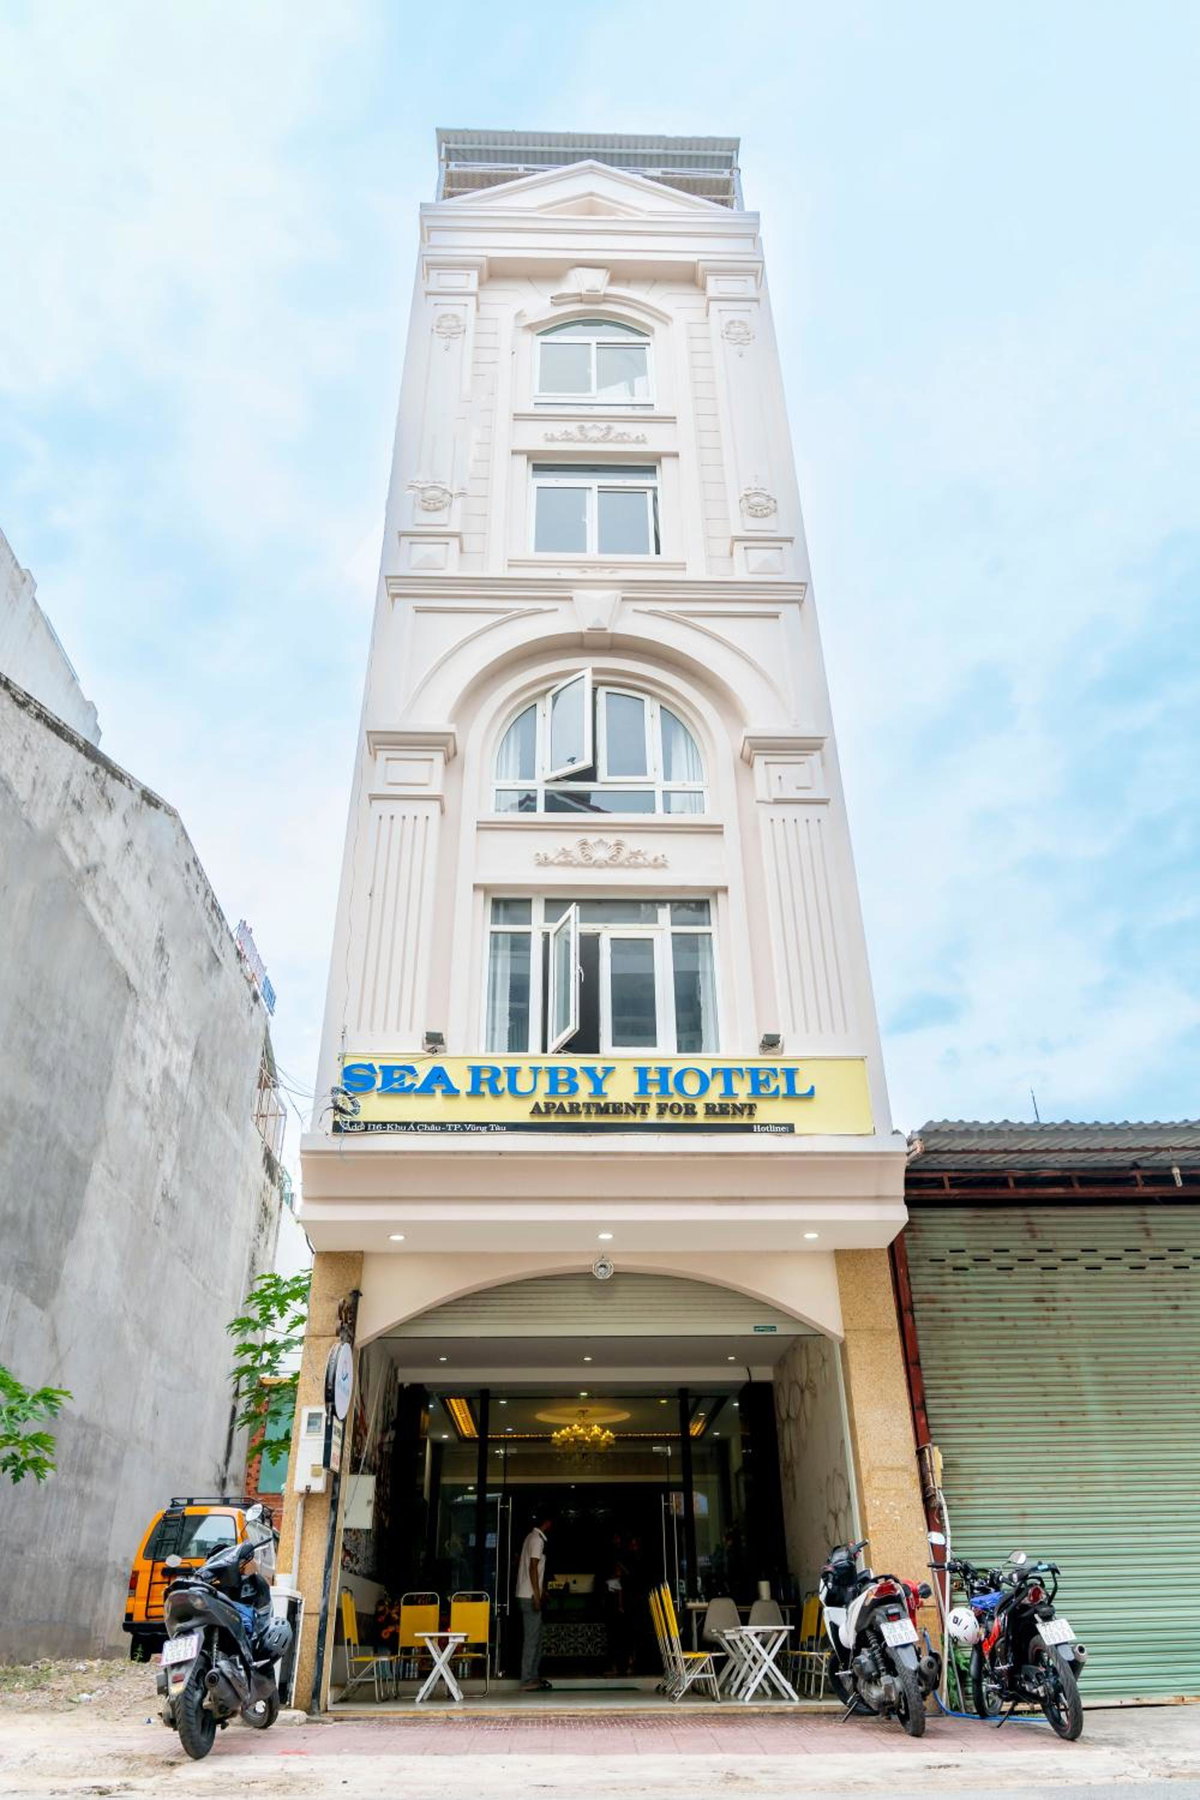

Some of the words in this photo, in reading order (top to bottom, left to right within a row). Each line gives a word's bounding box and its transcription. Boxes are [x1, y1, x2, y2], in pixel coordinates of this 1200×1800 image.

[342, 1063, 460, 1096] SEA
[467, 1065, 616, 1097] RUBY
[633, 1067, 816, 1099] HOTEL
[530, 1102, 650, 1117] APARTMENT
[656, 1102, 697, 1117] FOR
[704, 1103, 757, 1117] RENT
[753, 1124, 789, 1132] Hotline:
